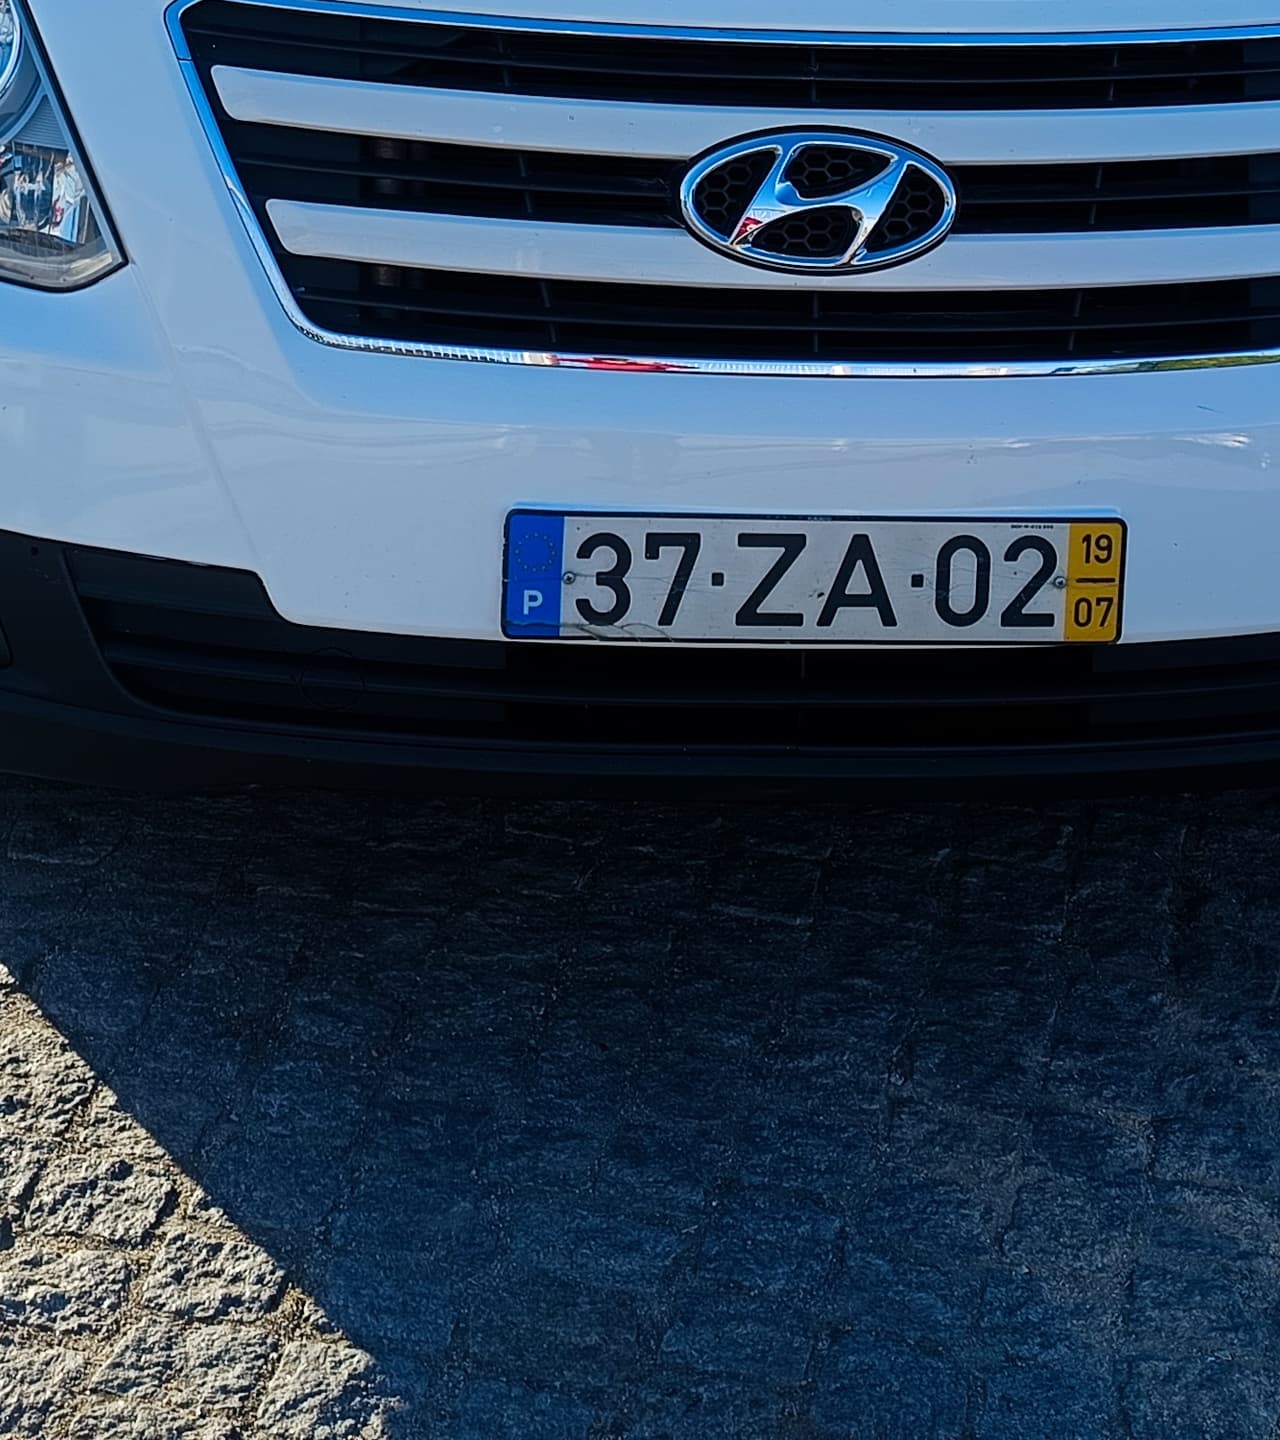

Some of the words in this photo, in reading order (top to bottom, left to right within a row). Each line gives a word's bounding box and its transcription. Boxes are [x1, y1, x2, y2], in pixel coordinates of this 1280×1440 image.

[1081, 533, 1113, 564] 19
[523, 589, 543, 616] P
[1073, 596, 1114, 628] 07
